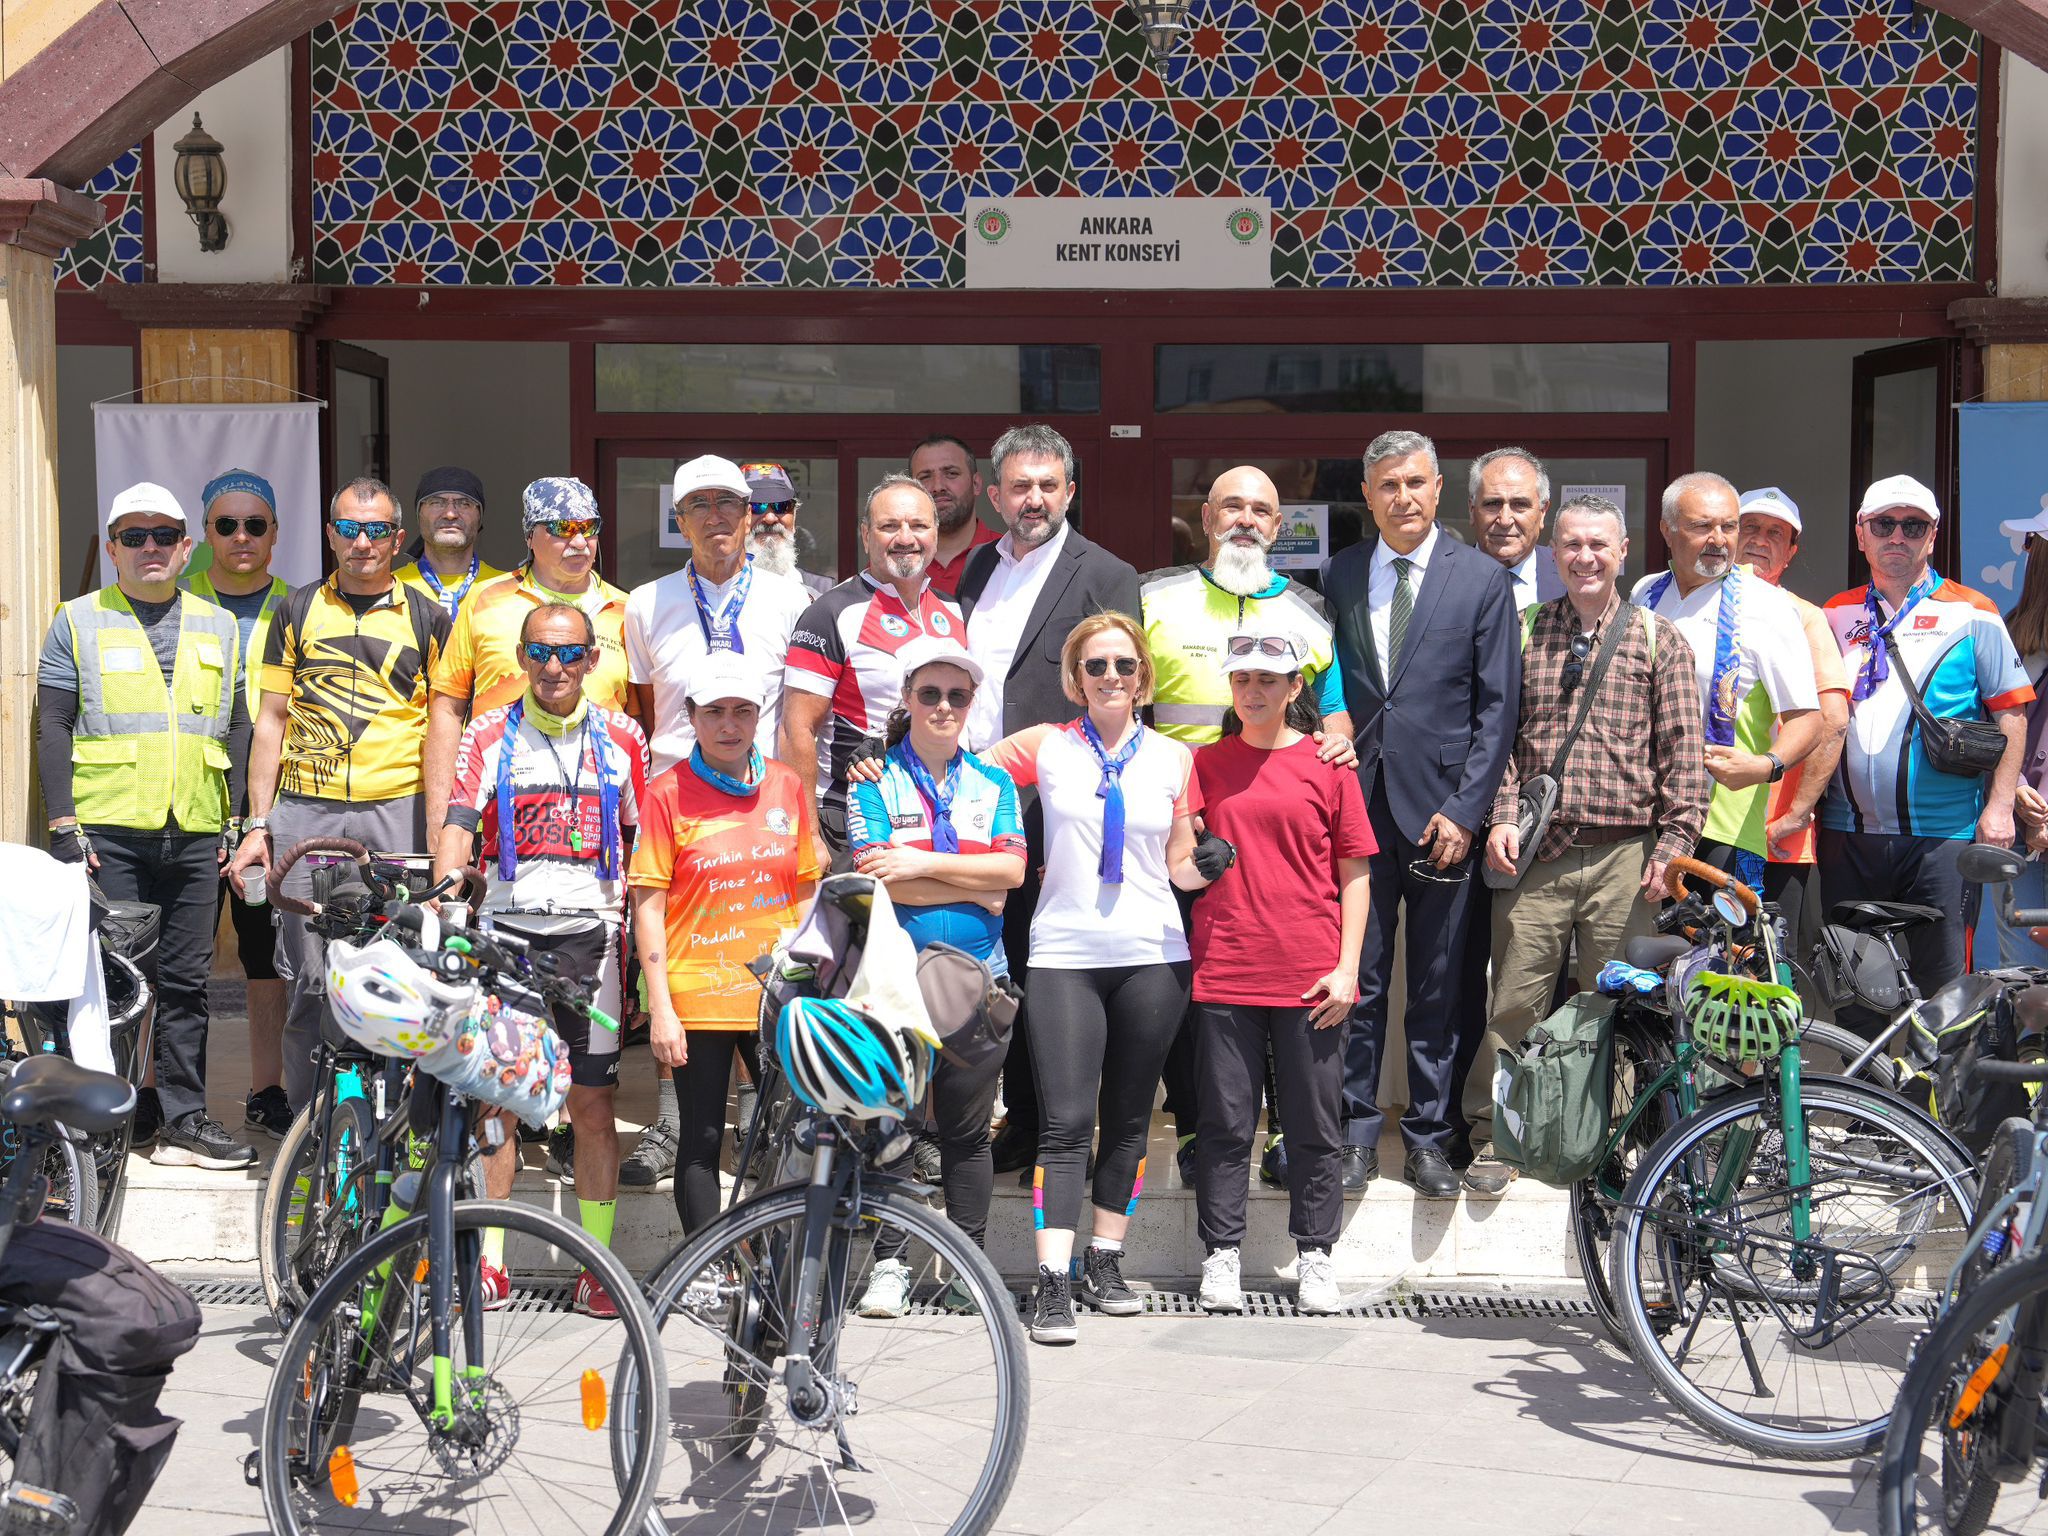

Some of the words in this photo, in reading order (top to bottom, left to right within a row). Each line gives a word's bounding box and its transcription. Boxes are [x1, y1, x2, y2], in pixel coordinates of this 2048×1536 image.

[1080, 217, 1153, 235] ANKARA
[1056, 243, 1101, 262] KENT
[1105, 239, 1180, 262] KONSEYİ
[692, 850, 743, 872] Tarihin
[751, 842, 785, 860] Kalbi
[709, 877, 747, 893] Enez
[728, 902, 746, 913] ve
[690, 925, 746, 949] Pedalla
